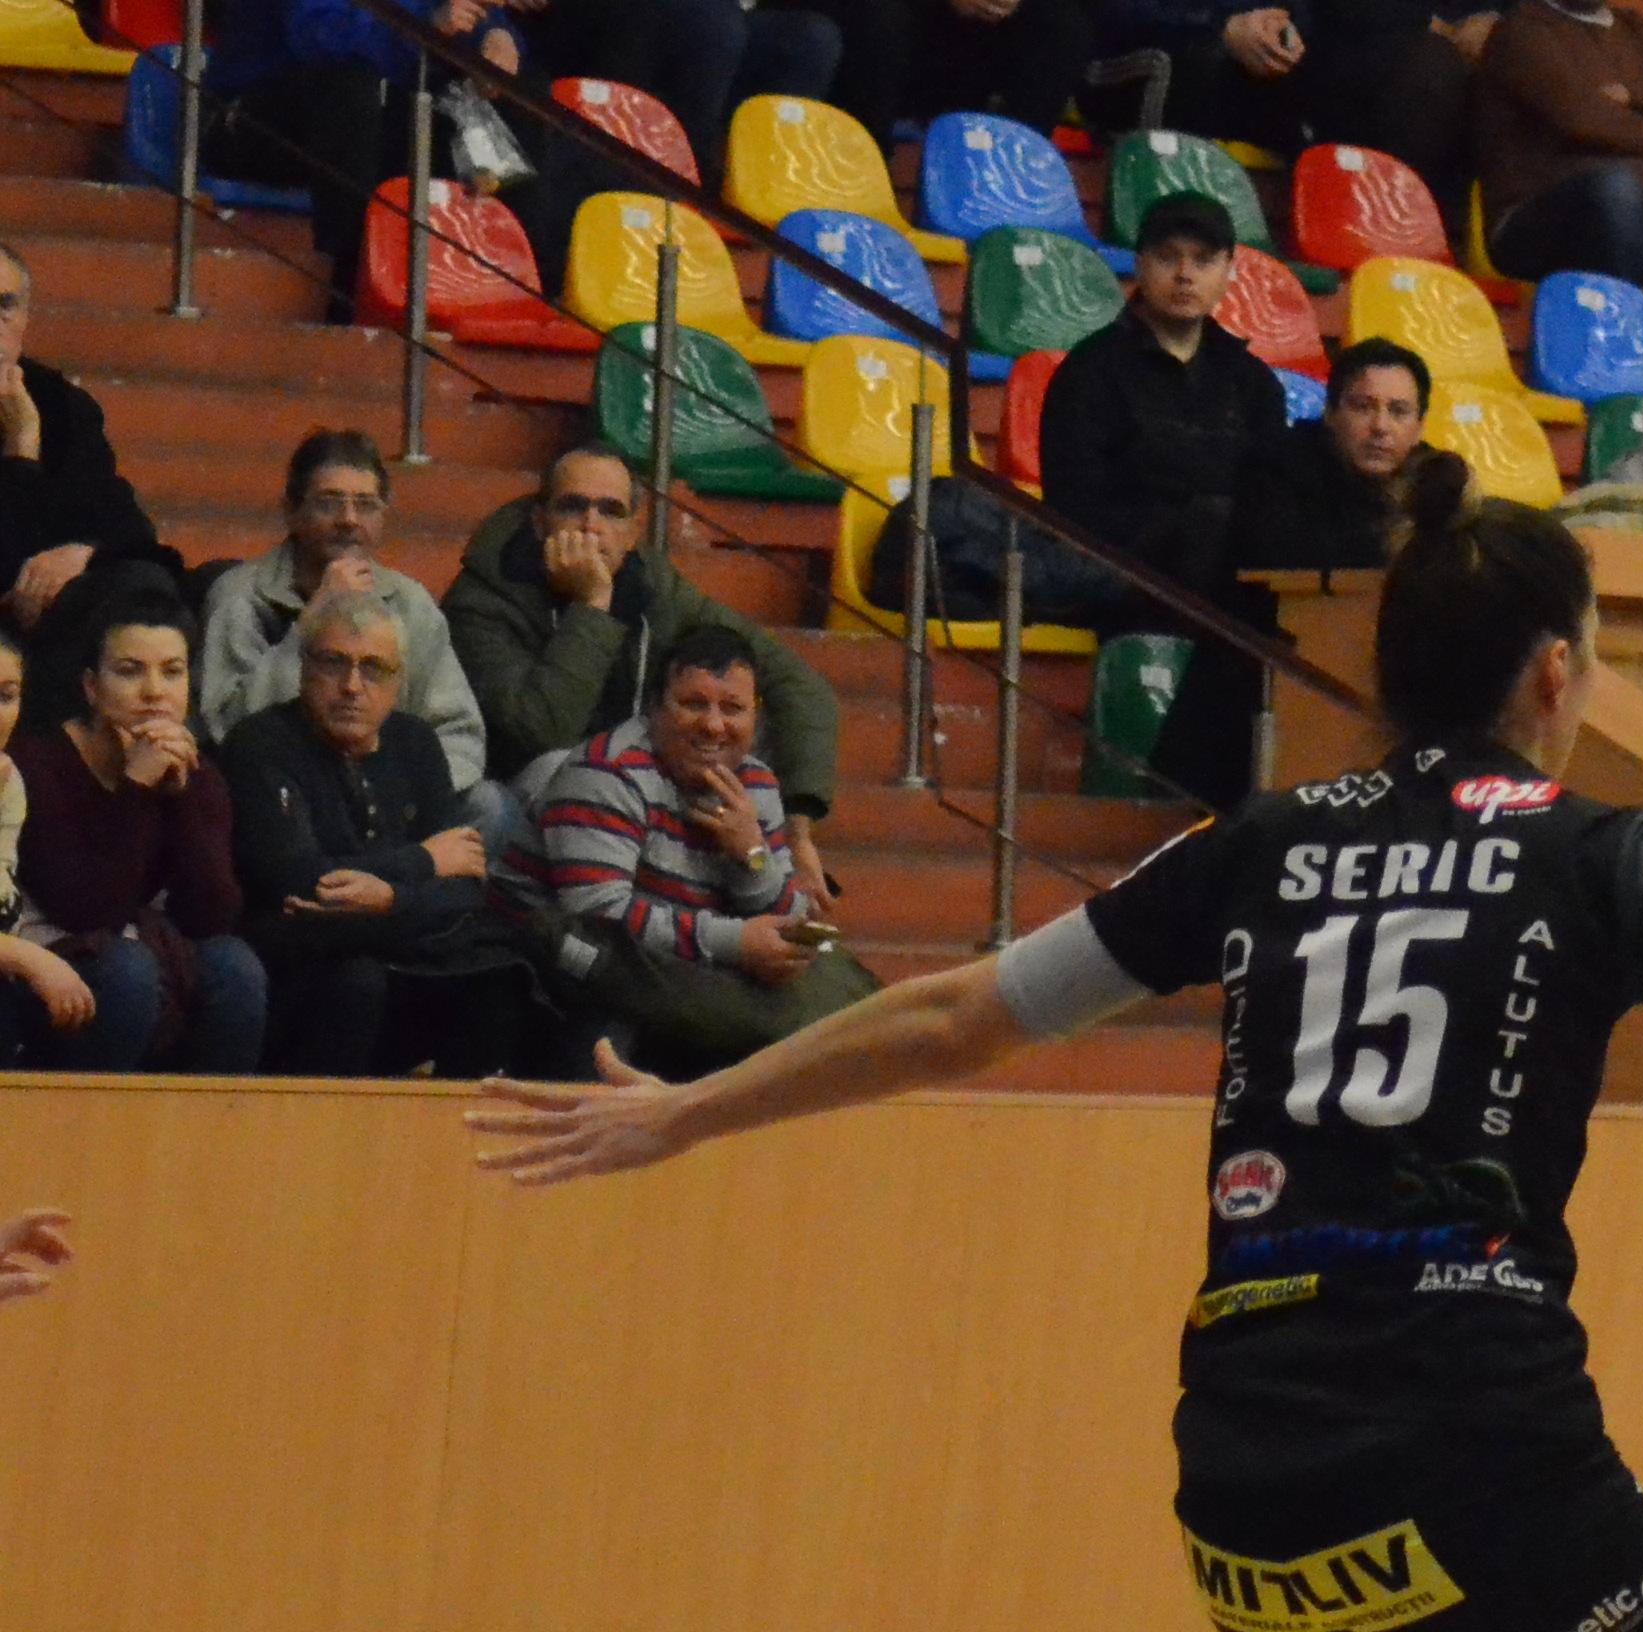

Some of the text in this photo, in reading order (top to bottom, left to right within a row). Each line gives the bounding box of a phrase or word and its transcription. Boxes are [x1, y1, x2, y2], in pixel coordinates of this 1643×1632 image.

[1279, 838, 1521, 901] SERIC
[1284, 907, 1470, 1127] 15
[1481, 919, 1555, 1138] ALUTUS
